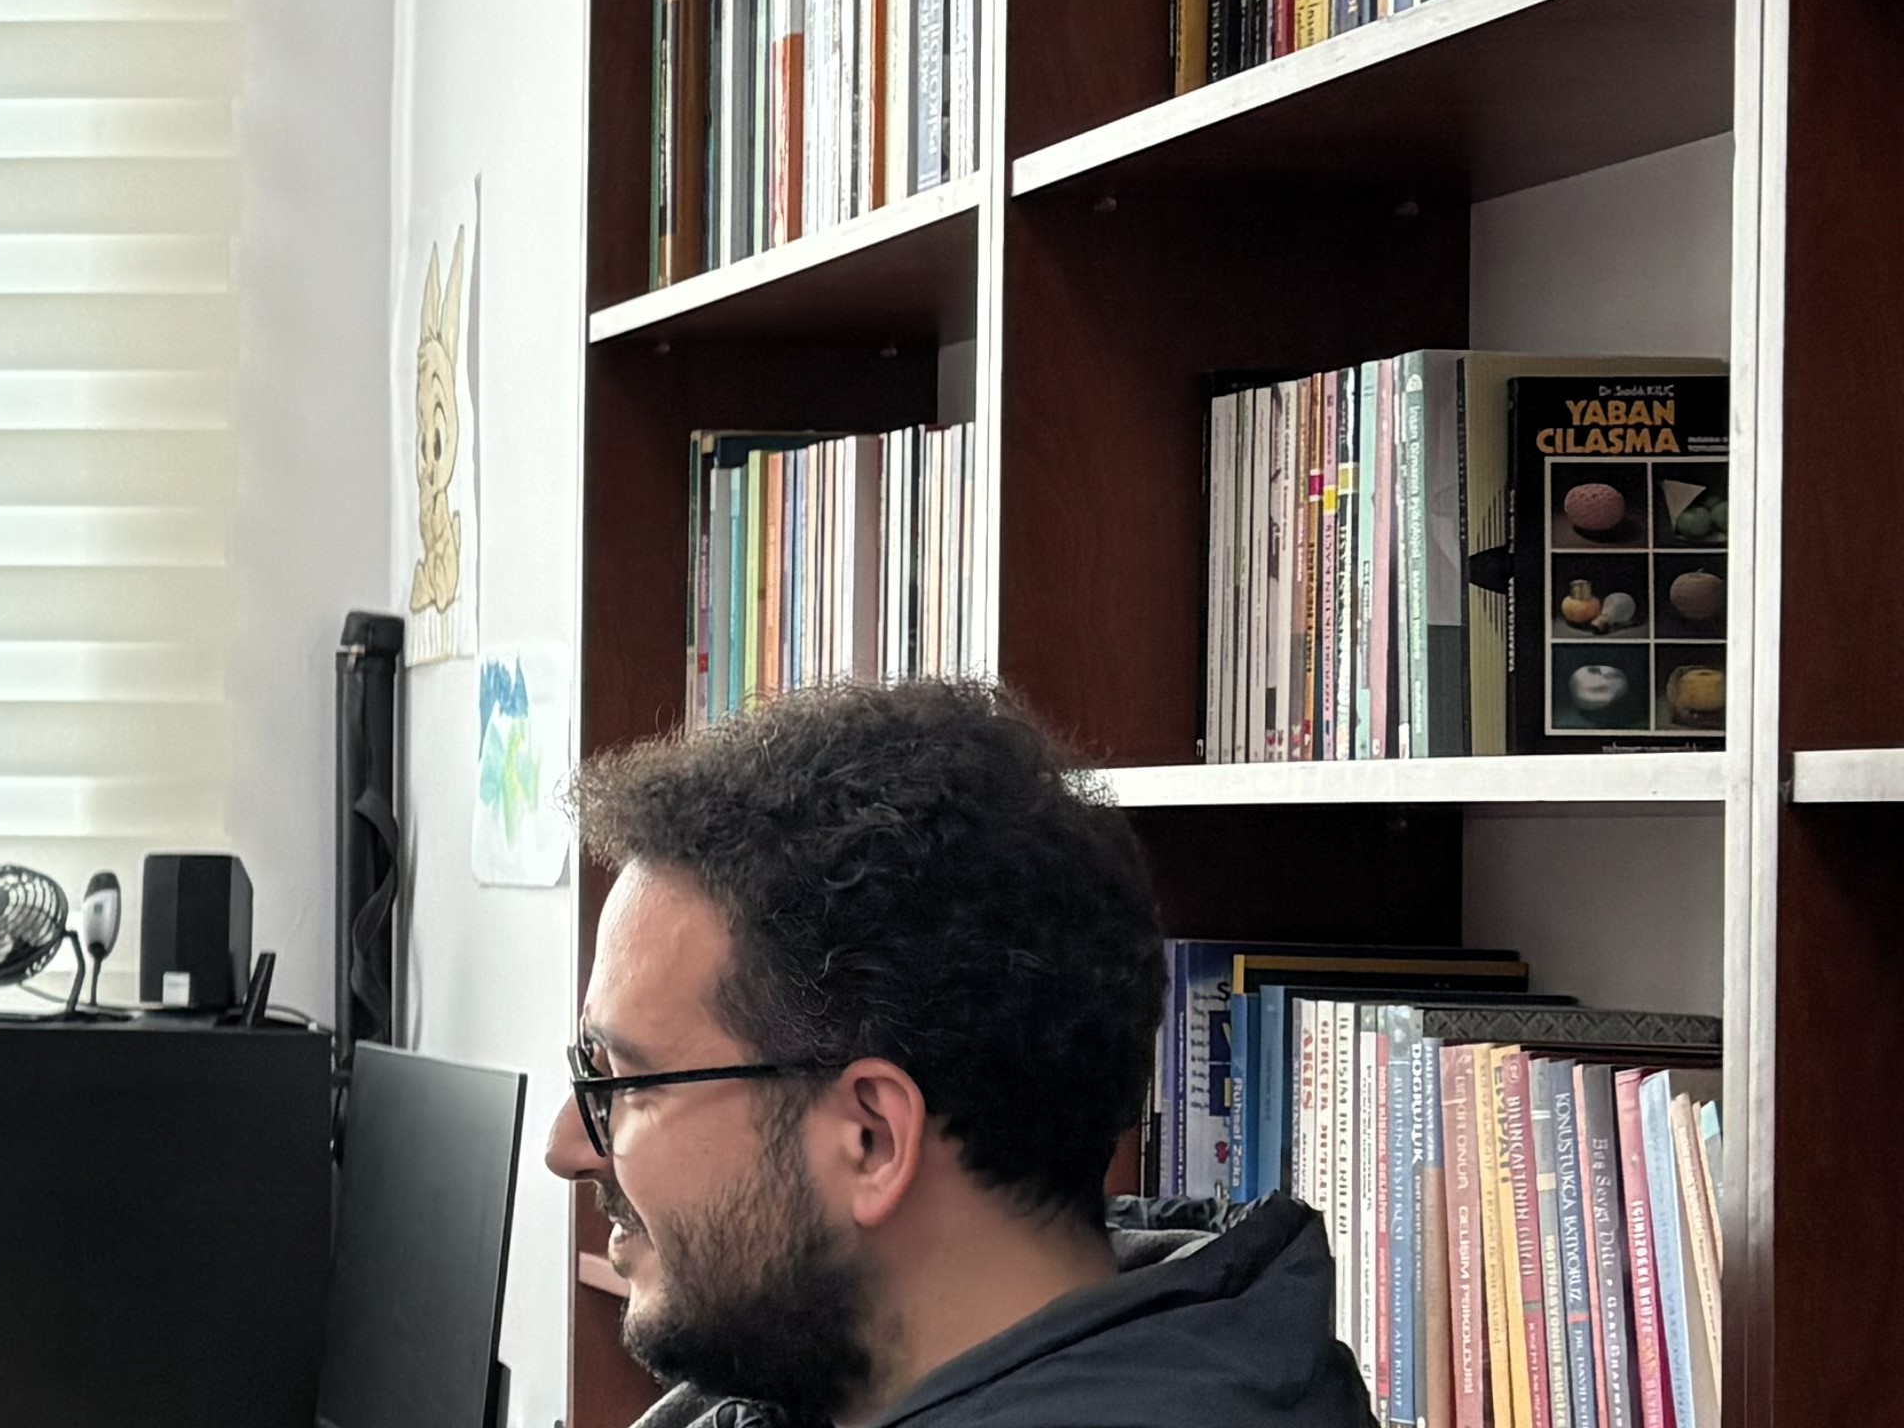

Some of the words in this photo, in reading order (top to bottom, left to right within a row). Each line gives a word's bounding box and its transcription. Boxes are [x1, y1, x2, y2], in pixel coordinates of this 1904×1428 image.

[1565, 399, 1676, 426] YABAN
[1231, 1077, 1243, 1139] Ruhsal
[1231, 1144, 1242, 1186] Zeka
[1456, 1134, 1469, 1188] ONUR
